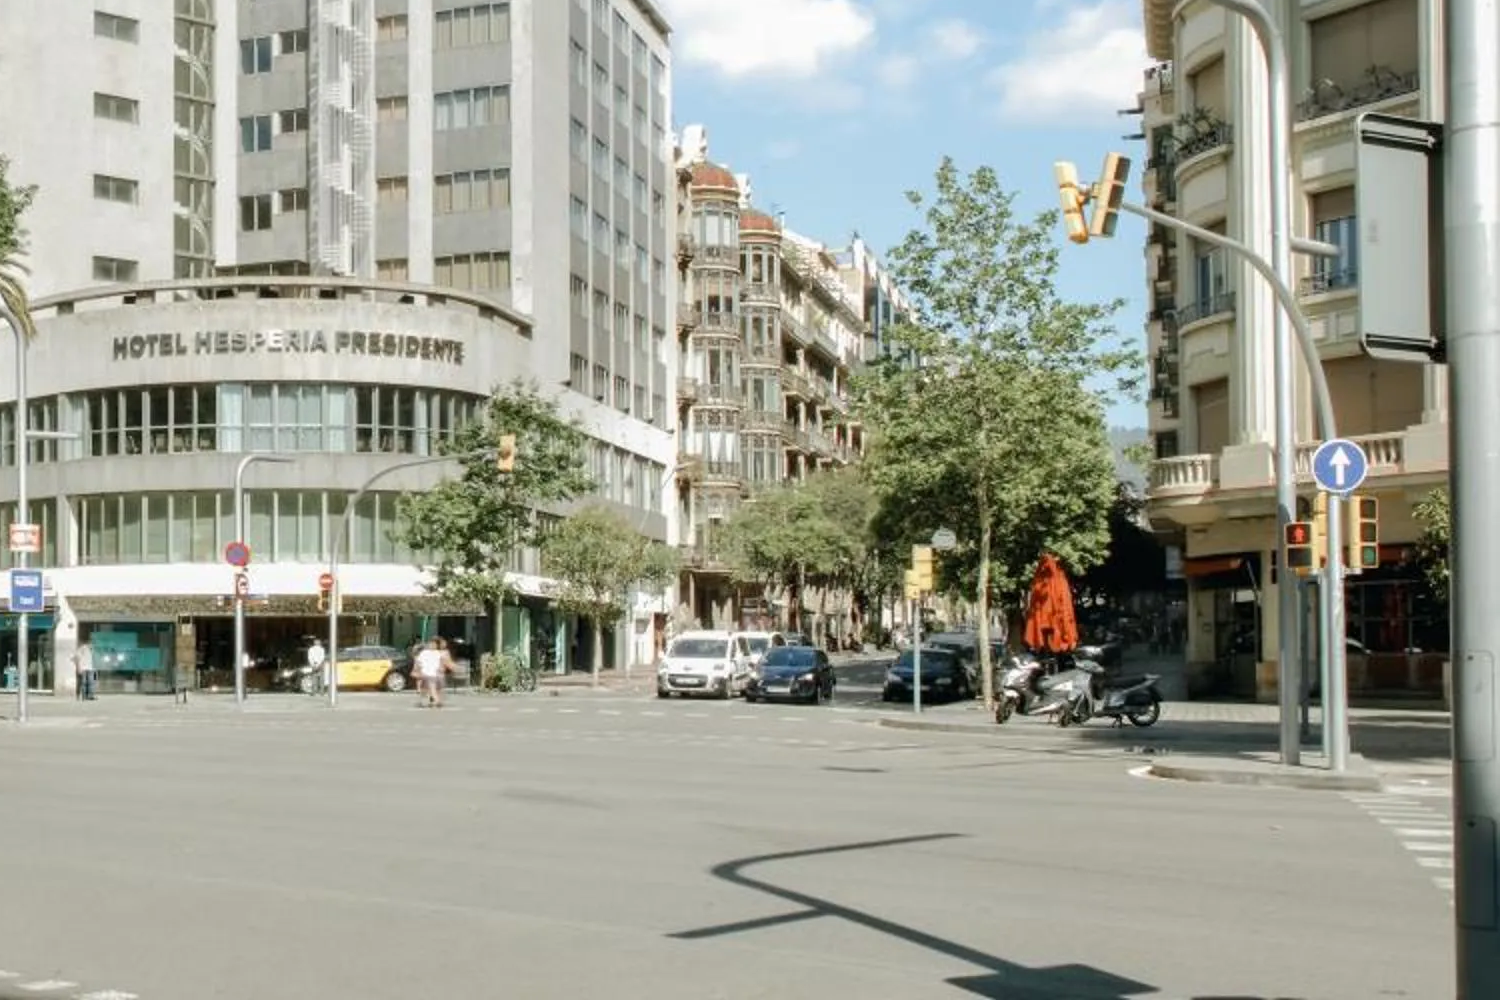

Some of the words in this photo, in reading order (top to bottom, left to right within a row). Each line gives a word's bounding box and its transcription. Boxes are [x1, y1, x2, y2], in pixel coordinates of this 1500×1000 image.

[113, 333, 187, 361] HOTEL
[195, 330, 327, 355] HESPERIA
[334, 331, 465, 366] PRESIDENTE
